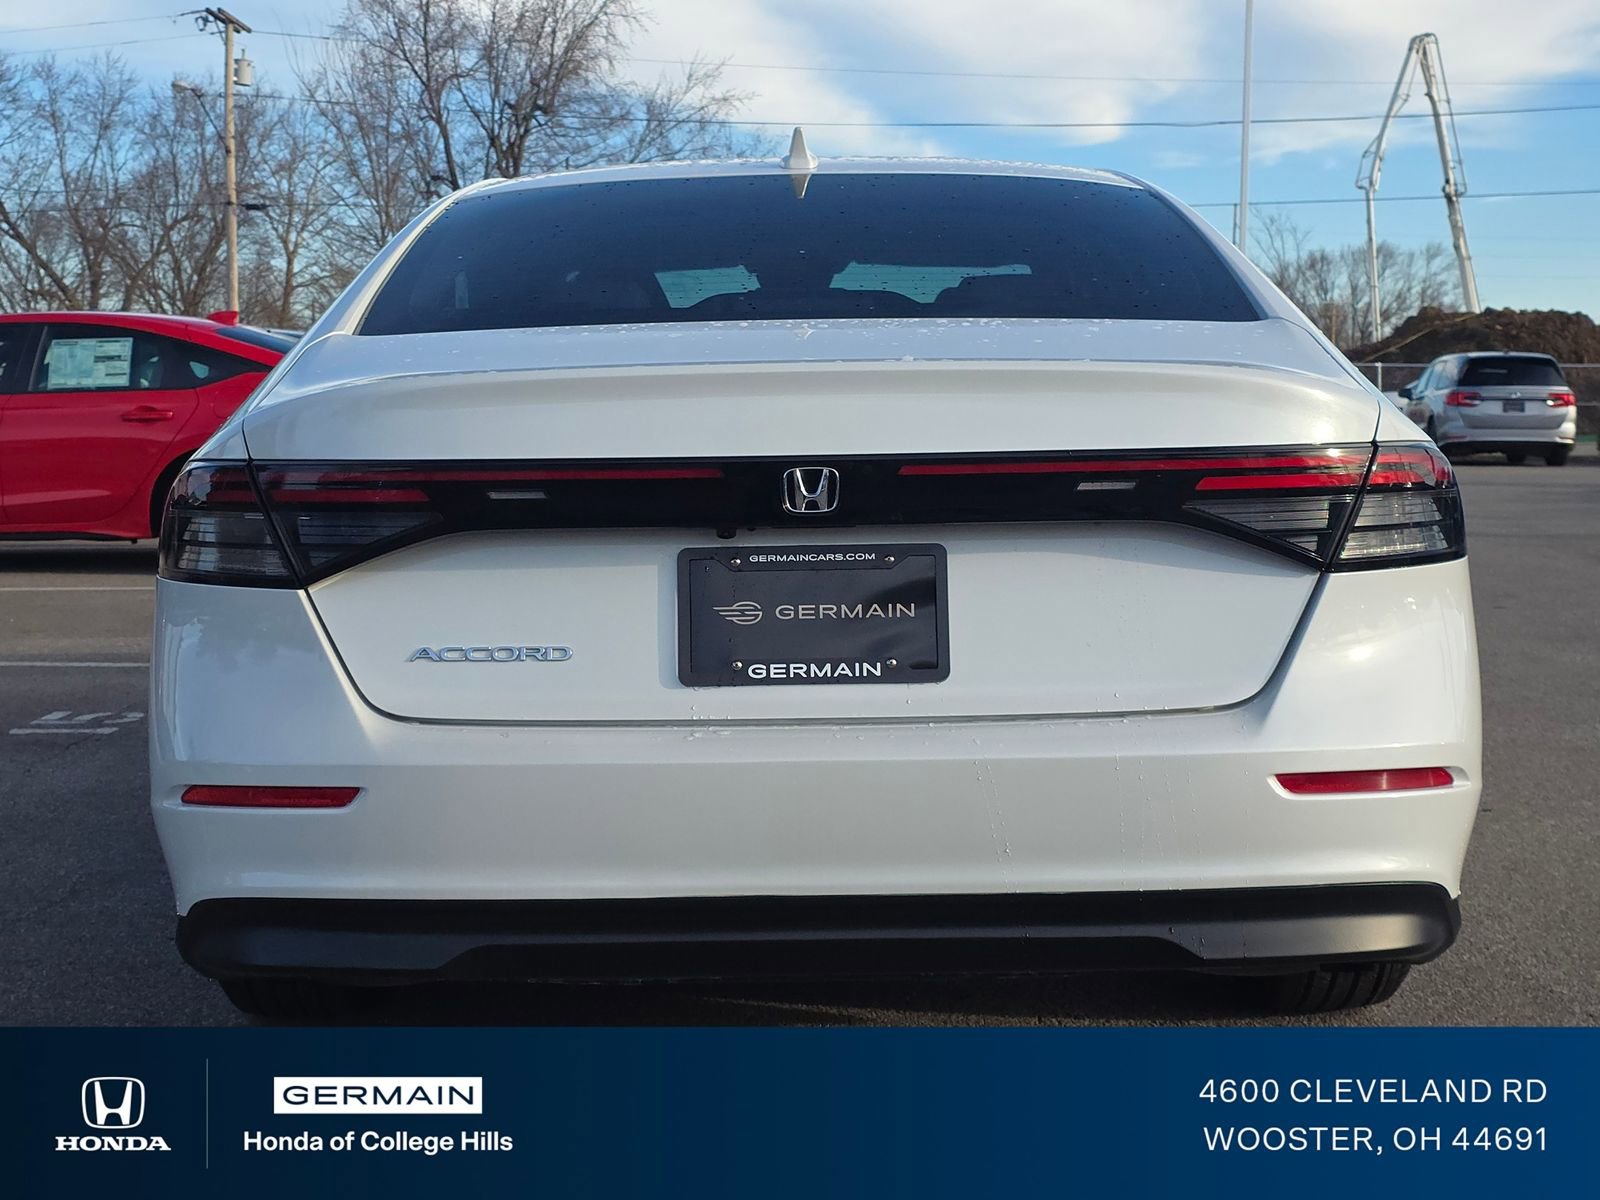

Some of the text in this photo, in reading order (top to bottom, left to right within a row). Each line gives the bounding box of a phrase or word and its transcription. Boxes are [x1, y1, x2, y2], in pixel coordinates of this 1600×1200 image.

[749, 552, 876, 563] GERMAINCARS.COM
[775, 603, 915, 620] GERMAIN
[409, 646, 573, 662] ACCORD
[747, 662, 882, 679] GERMAIN
